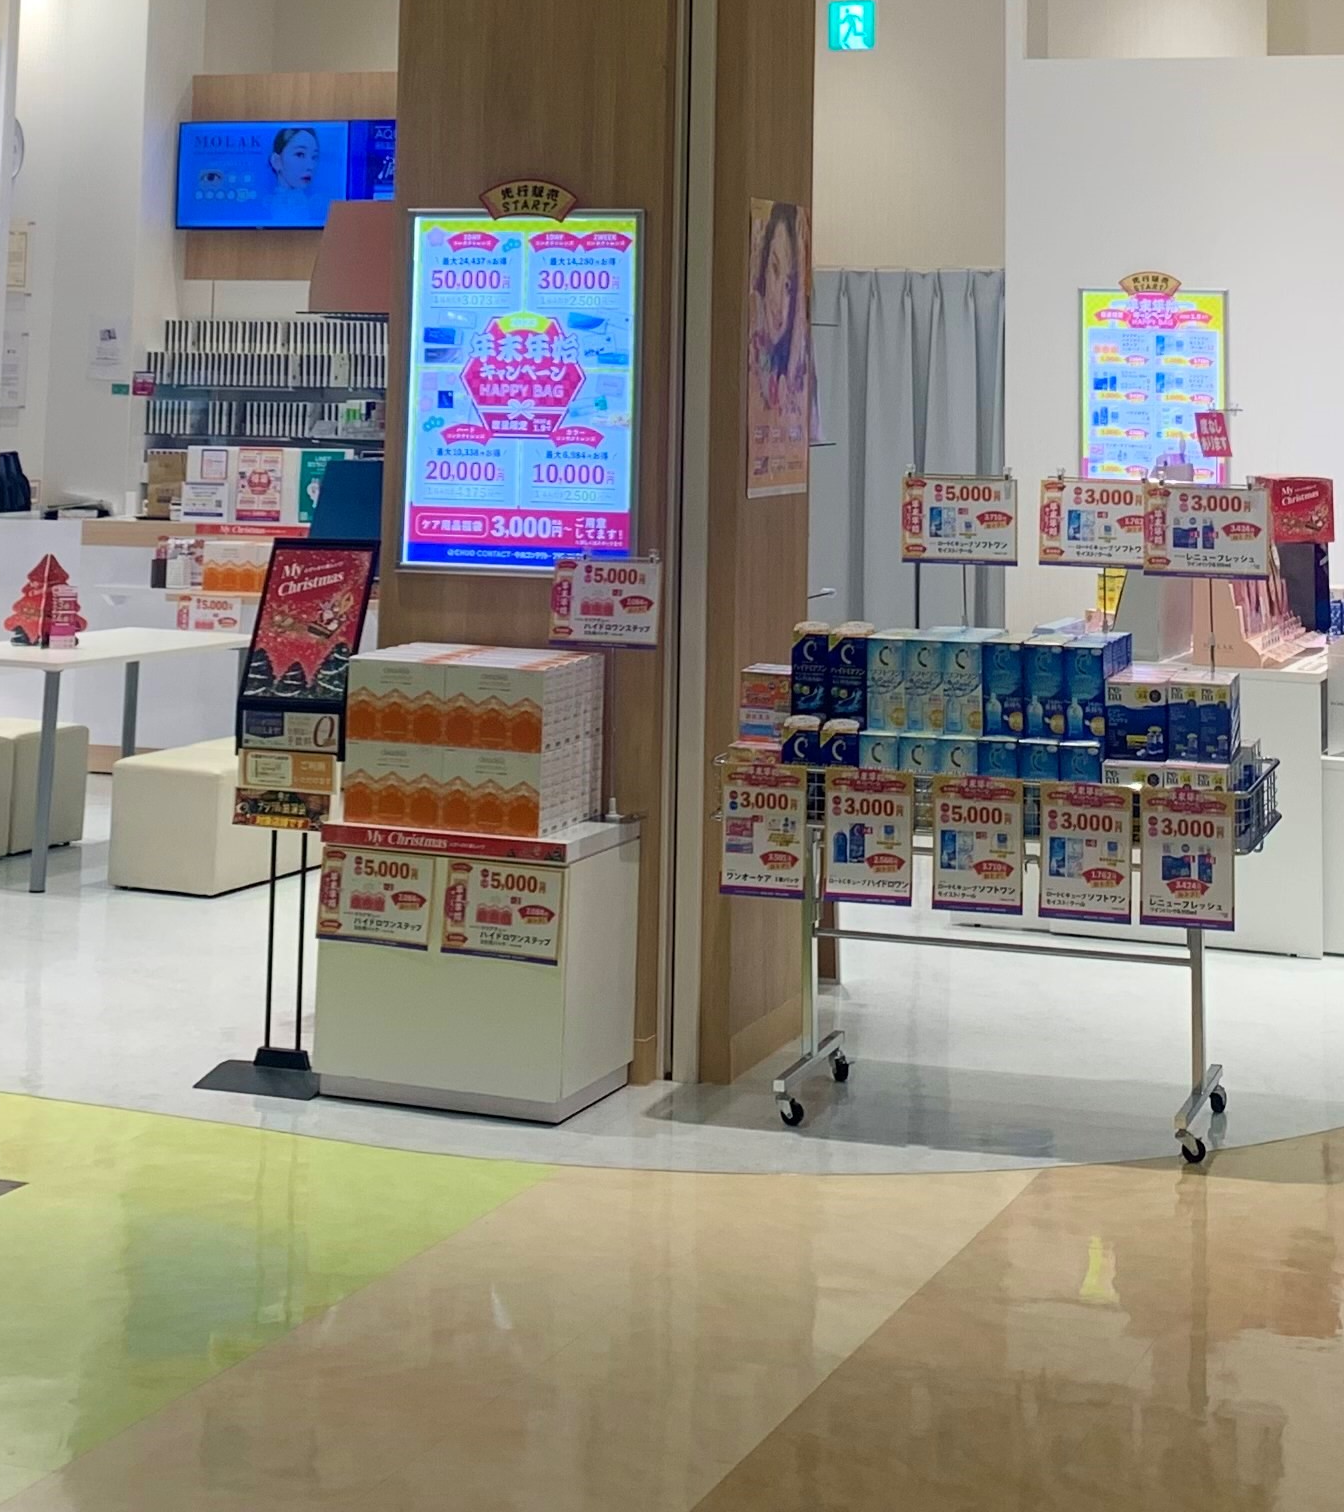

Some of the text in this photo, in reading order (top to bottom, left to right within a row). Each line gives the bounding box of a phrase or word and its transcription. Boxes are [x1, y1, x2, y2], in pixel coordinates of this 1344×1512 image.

[479, 382, 564, 399] HAPPY BAG
[1280, 486, 1295, 497] My
[1280, 491, 1320, 506] Christmas
[281, 562, 305, 579] My
[277, 571, 345, 597] Christmas
[583, 623, 651, 633] ハイドロワンステップ
[366, 829, 448, 850] My Christmas
[726, 872, 772, 882] ワンオーケア
[1149, 896, 1223, 912] レニューフレッシュ
[353, 917, 423, 932] ハイドロワンステップ
[479, 930, 552, 947] ハイドロワンステップ
